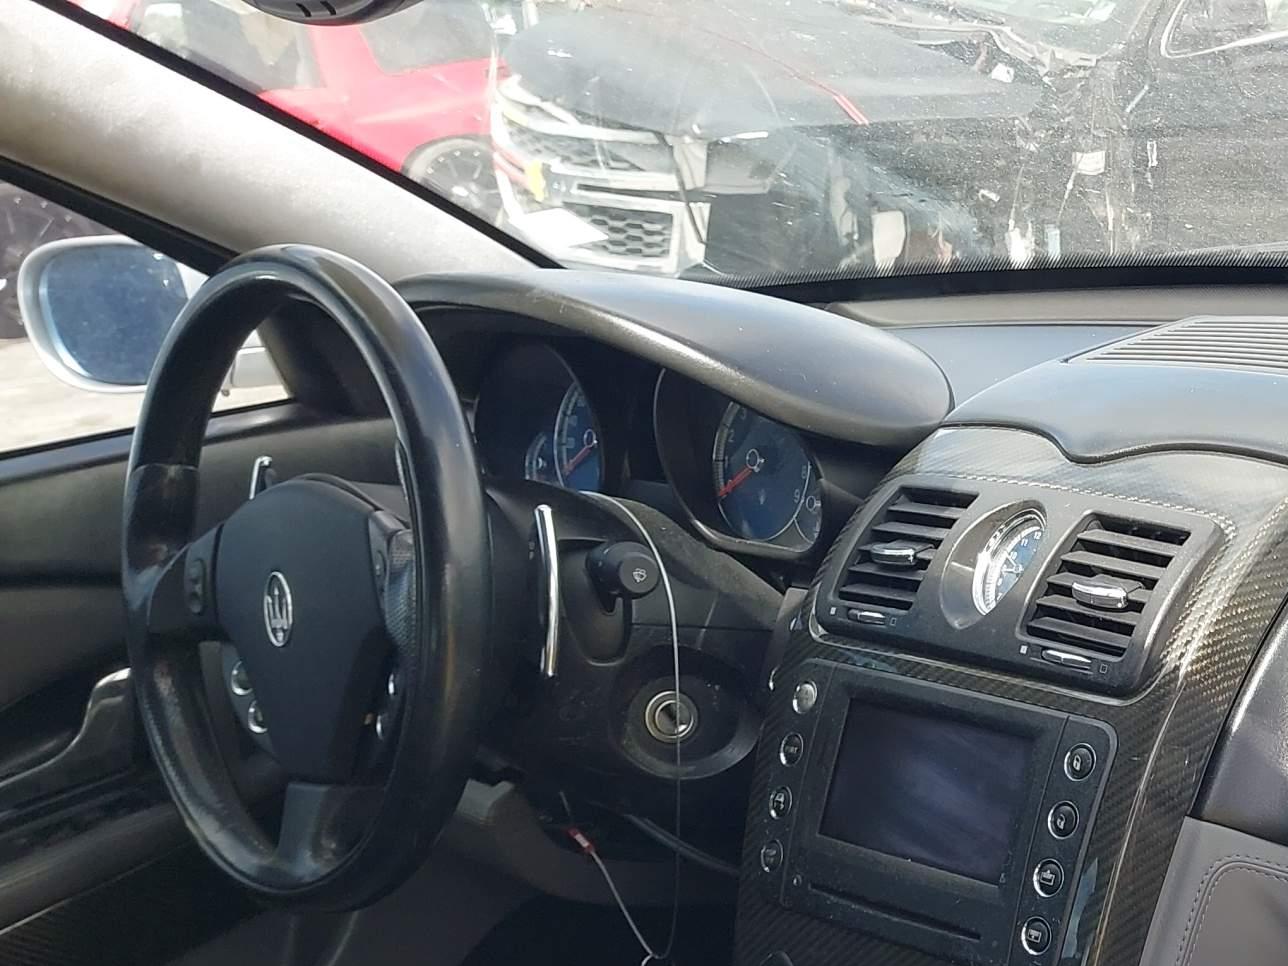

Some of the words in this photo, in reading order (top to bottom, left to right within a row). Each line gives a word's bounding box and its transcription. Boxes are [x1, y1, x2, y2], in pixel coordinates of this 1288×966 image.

[728, 428, 736, 443] 2
[793, 488, 801, 504] 9
[1034, 531, 1042, 540] 12
